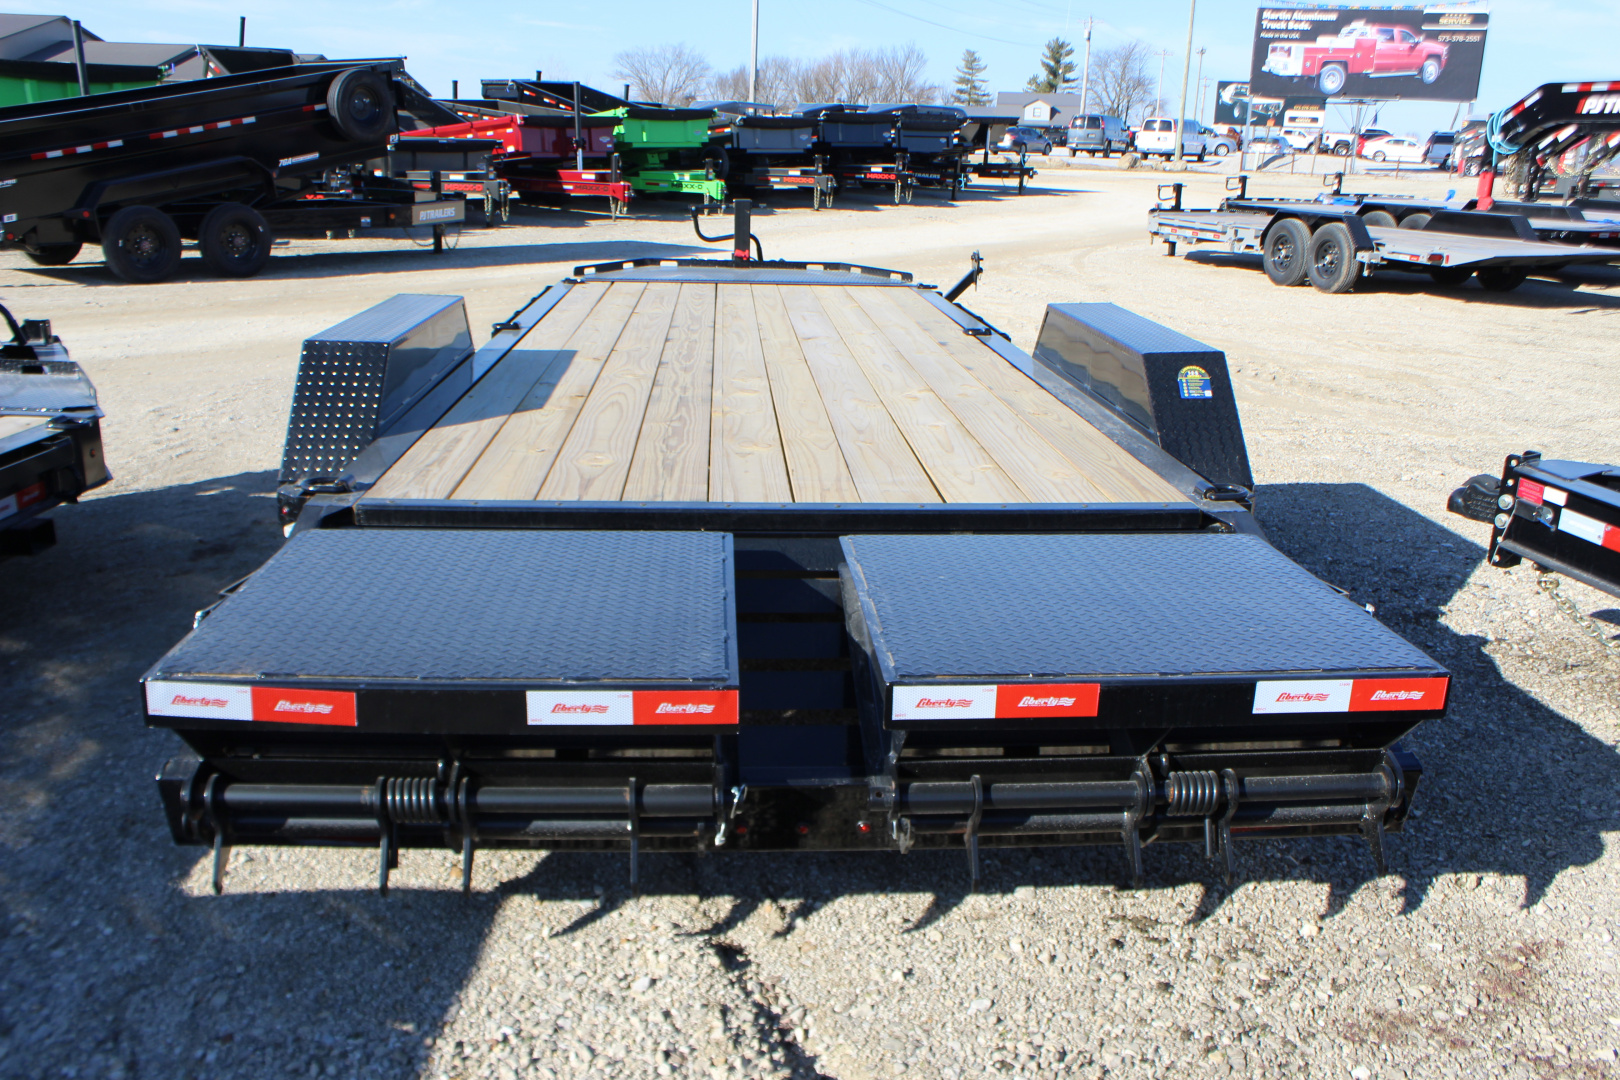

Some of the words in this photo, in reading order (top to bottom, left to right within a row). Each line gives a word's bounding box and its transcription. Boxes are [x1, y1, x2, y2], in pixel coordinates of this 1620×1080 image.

[1262, 10, 1292, 20] Martin
[1292, 10, 1338, 21] Aluminum
[1261, 20, 1287, 30] Truck
[1287, 20, 1312, 31] Beds.
[671, 181, 703, 189] MAXX-D
[783, 176, 815, 184] MAXX-D
[444, 183, 484, 192] MAXX-D
[575, 184, 609, 192] MAXX-D
[1275, 692, 1315, 703] Liberty
[1370, 690, 1408, 701] Liberty
[171, 695, 211, 708] Liberty
[274, 700, 316, 713] Liberty
[915, 697, 957, 709] Liberty
[1018, 696, 1060, 708] Liberty
[551, 703, 593, 714] Liberty
[655, 702, 698, 714] Liberty
